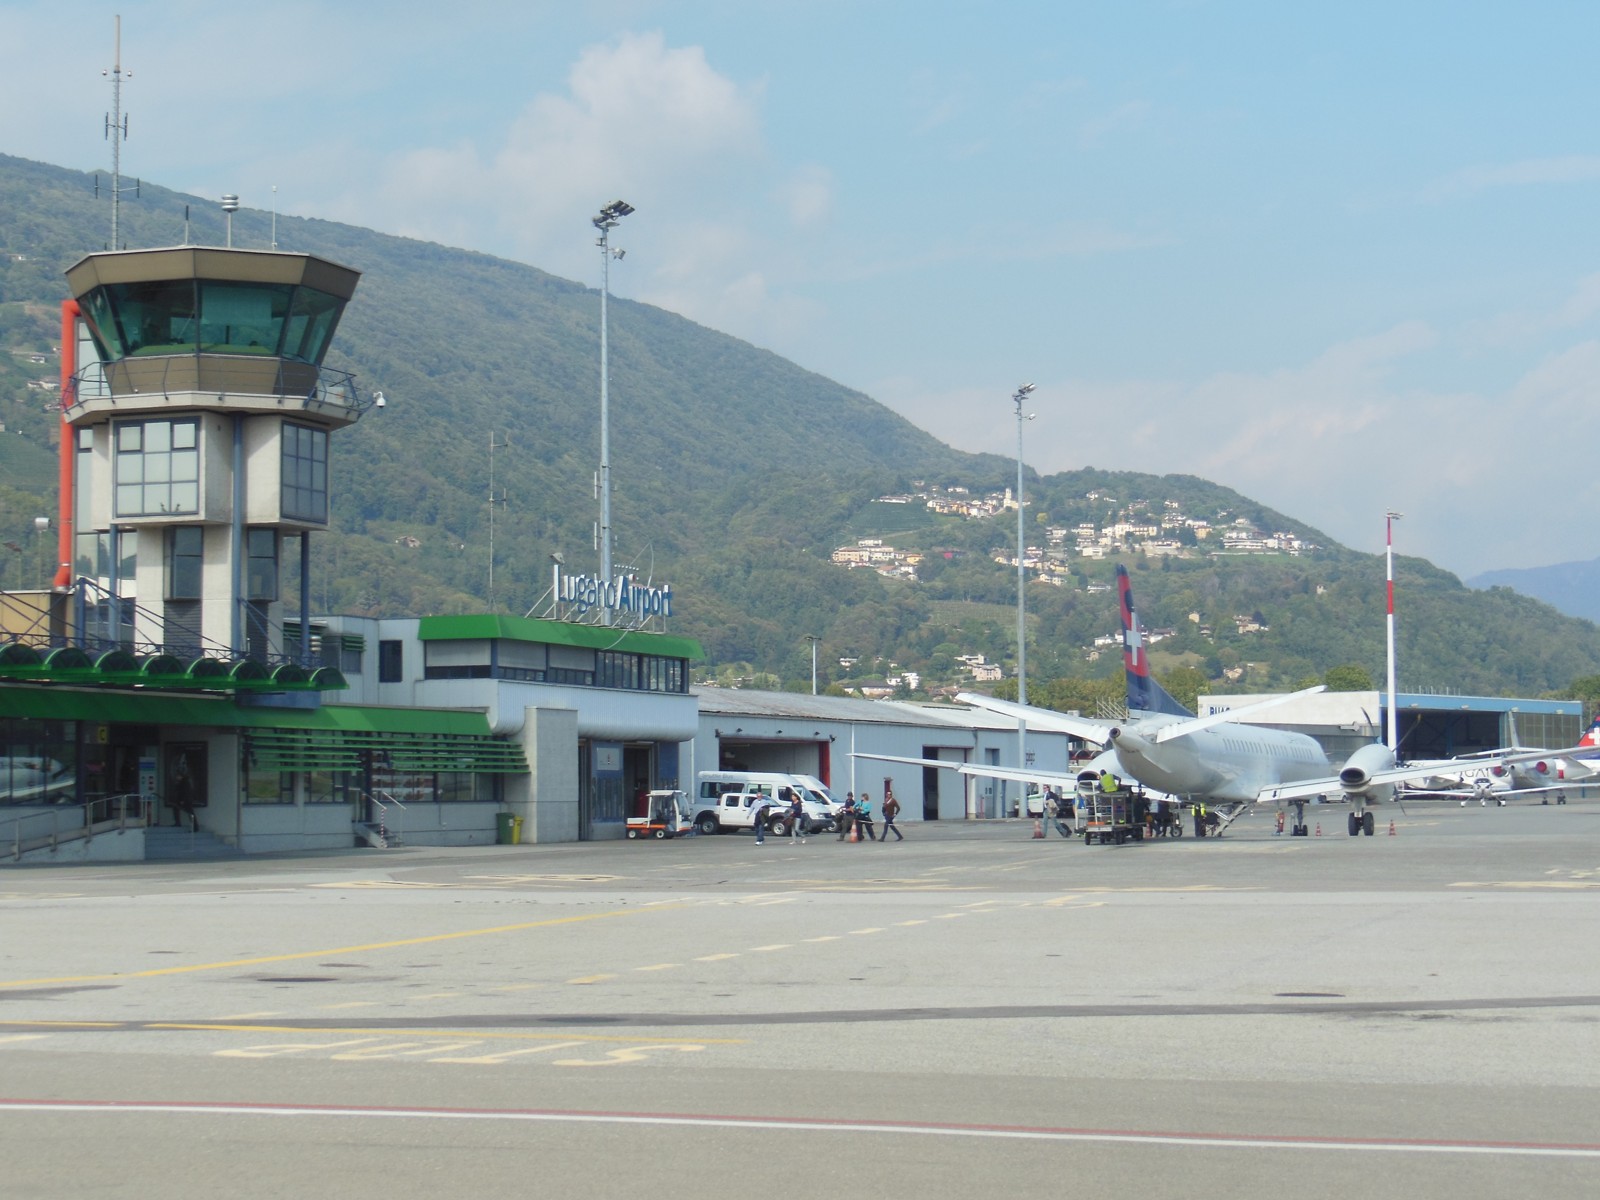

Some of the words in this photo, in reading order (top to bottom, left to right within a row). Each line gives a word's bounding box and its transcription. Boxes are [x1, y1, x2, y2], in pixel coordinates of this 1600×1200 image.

[554, 564, 615, 614] Lugano
[615, 575, 673, 622] Airport
[213, 1038, 706, 1065] STOP
